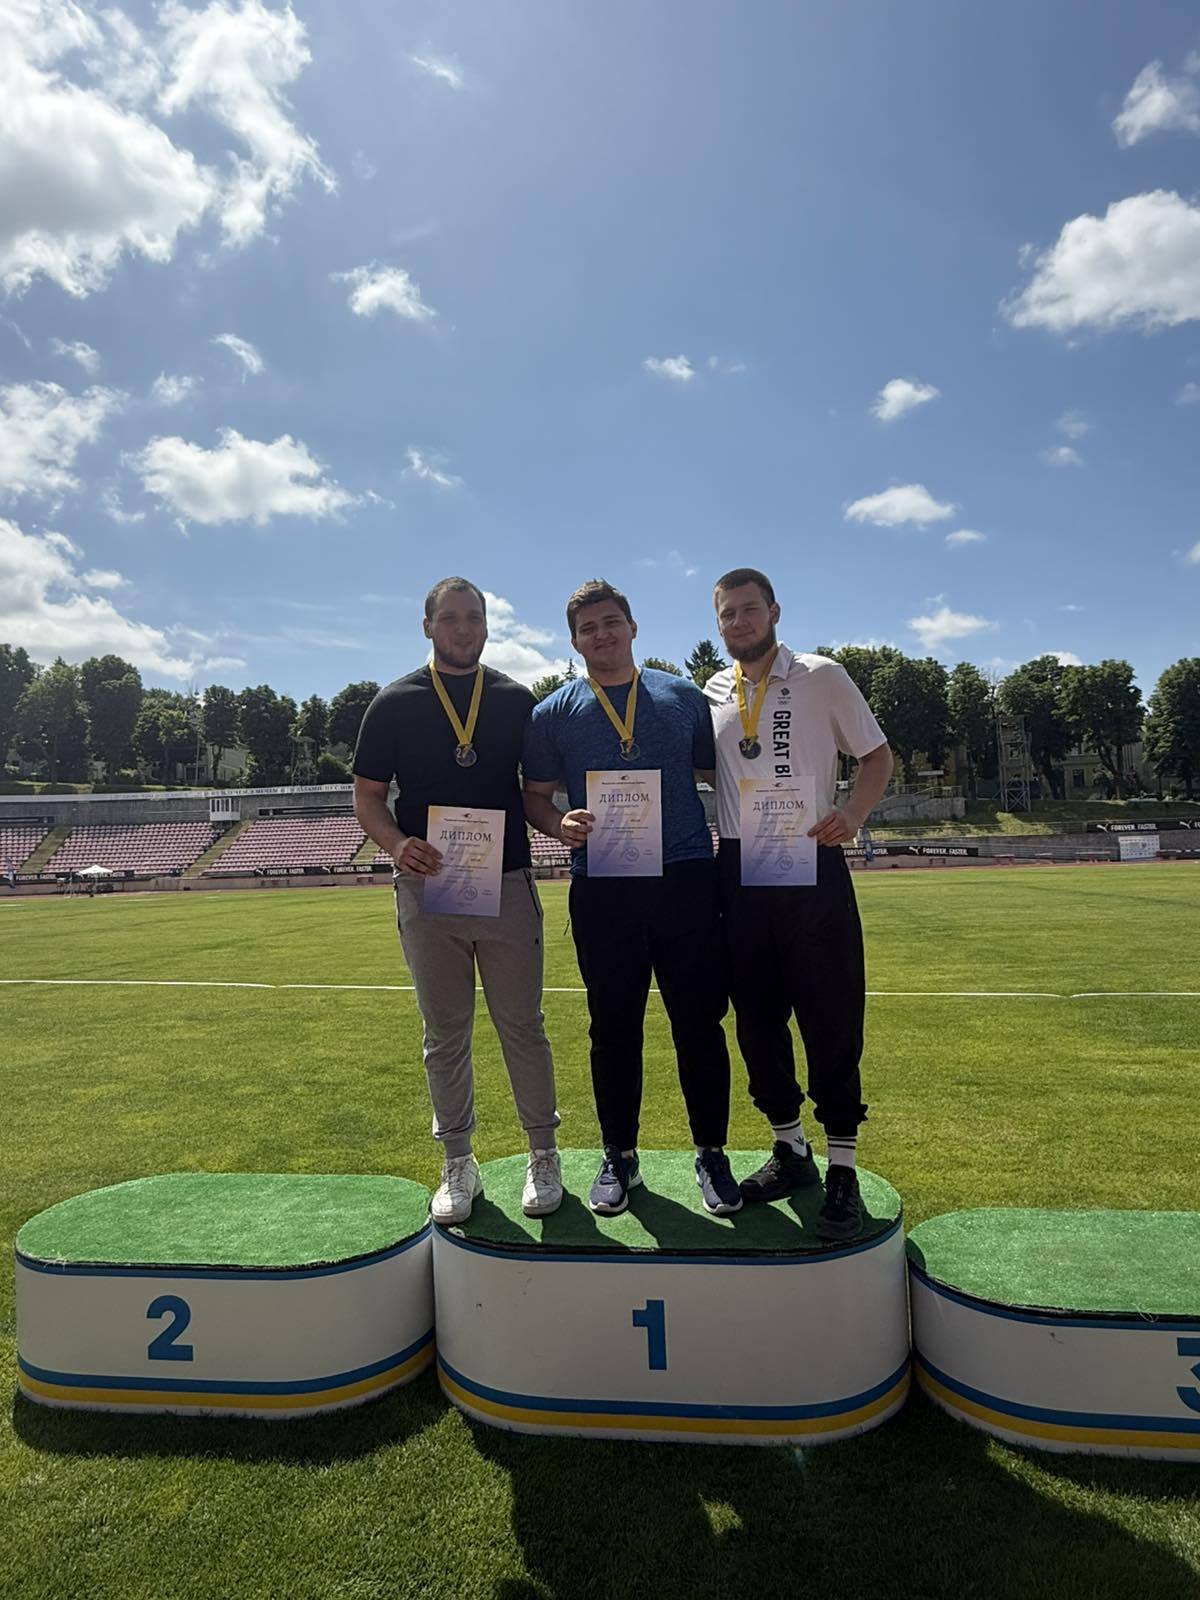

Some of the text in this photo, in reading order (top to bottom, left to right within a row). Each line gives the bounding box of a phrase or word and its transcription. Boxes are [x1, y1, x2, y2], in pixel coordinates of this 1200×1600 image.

[773, 710, 792, 760] GREAT
[600, 793, 650, 803] ДИПЛОМ
[753, 800, 805, 812] ДИПЛОМ
[440, 830, 492, 842] ДИПЛОМ
[146, 1294, 194, 1362] 2
[631, 1298, 668, 1371] 1
